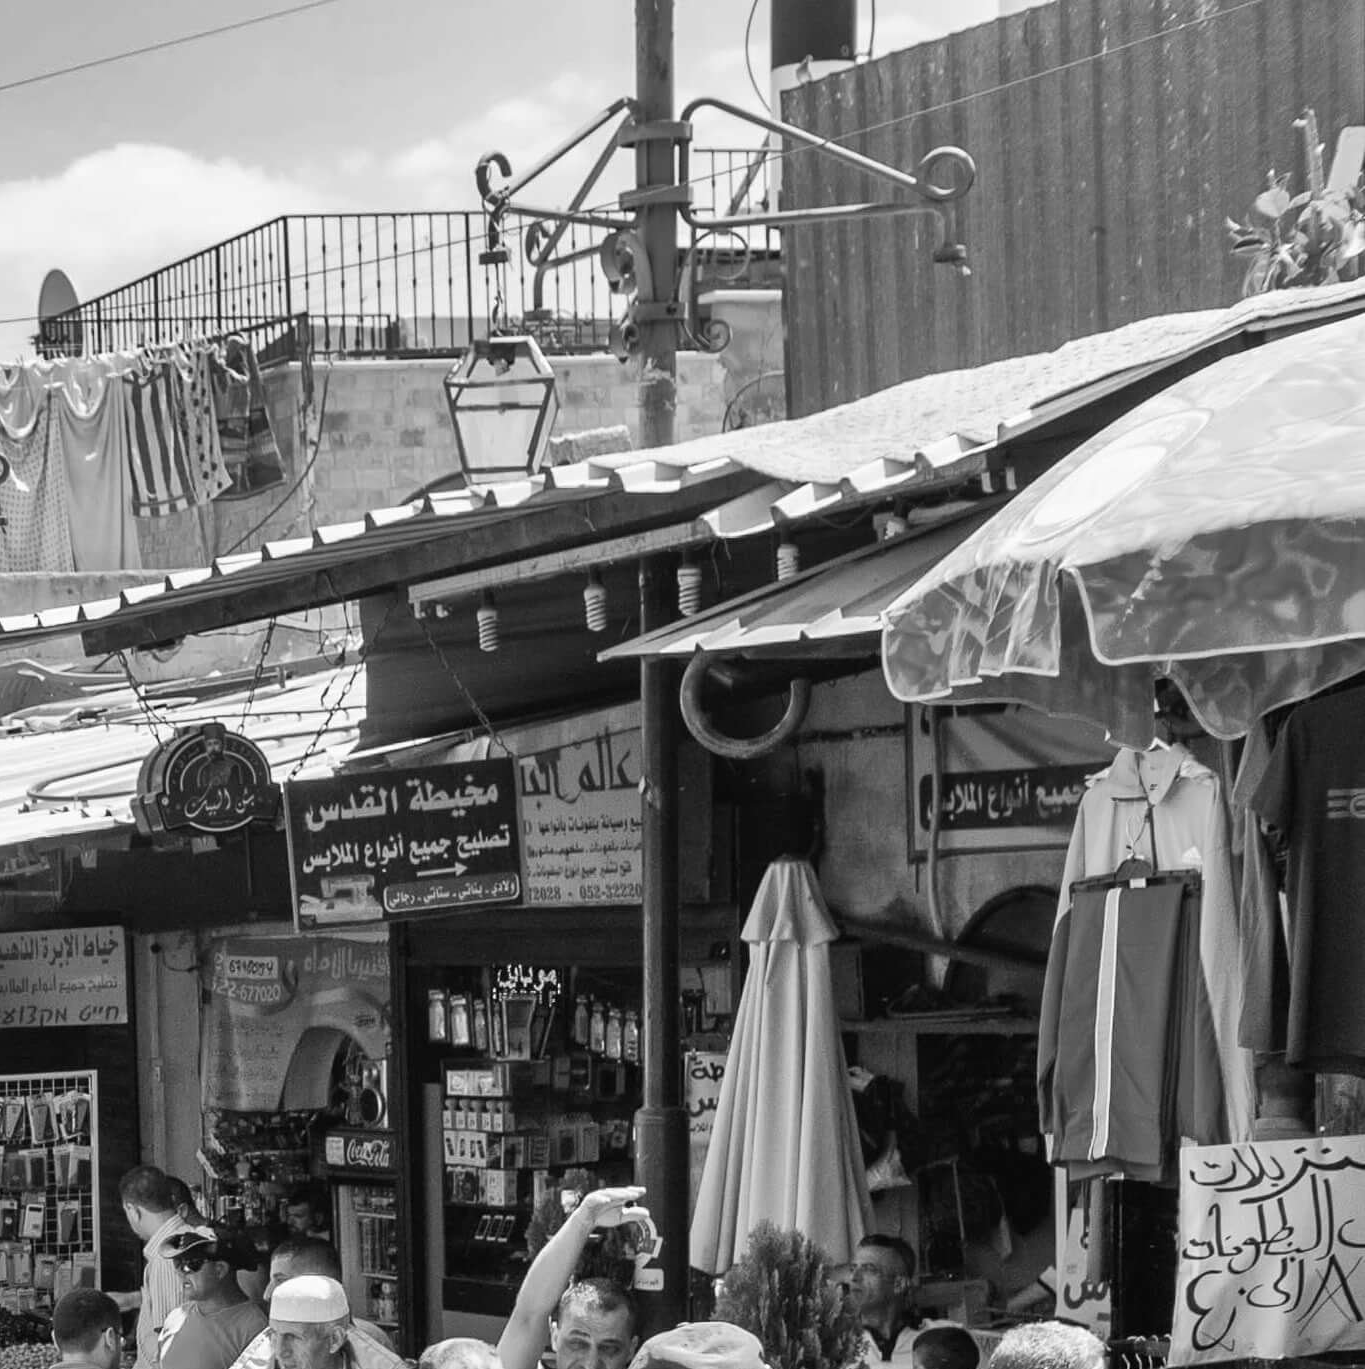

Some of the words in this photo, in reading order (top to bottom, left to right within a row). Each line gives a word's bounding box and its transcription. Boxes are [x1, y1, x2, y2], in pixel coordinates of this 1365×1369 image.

[305, 785, 398, 832] القدس
[406, 774, 499, 818] مخيطة
[302, 842, 359, 874] الملابس
[364, 831, 404, 873] أنواع
[408, 834, 451, 865] جميع
[456, 823, 511, 858] تصليح
[79, 1005, 119, 1022] חייט
